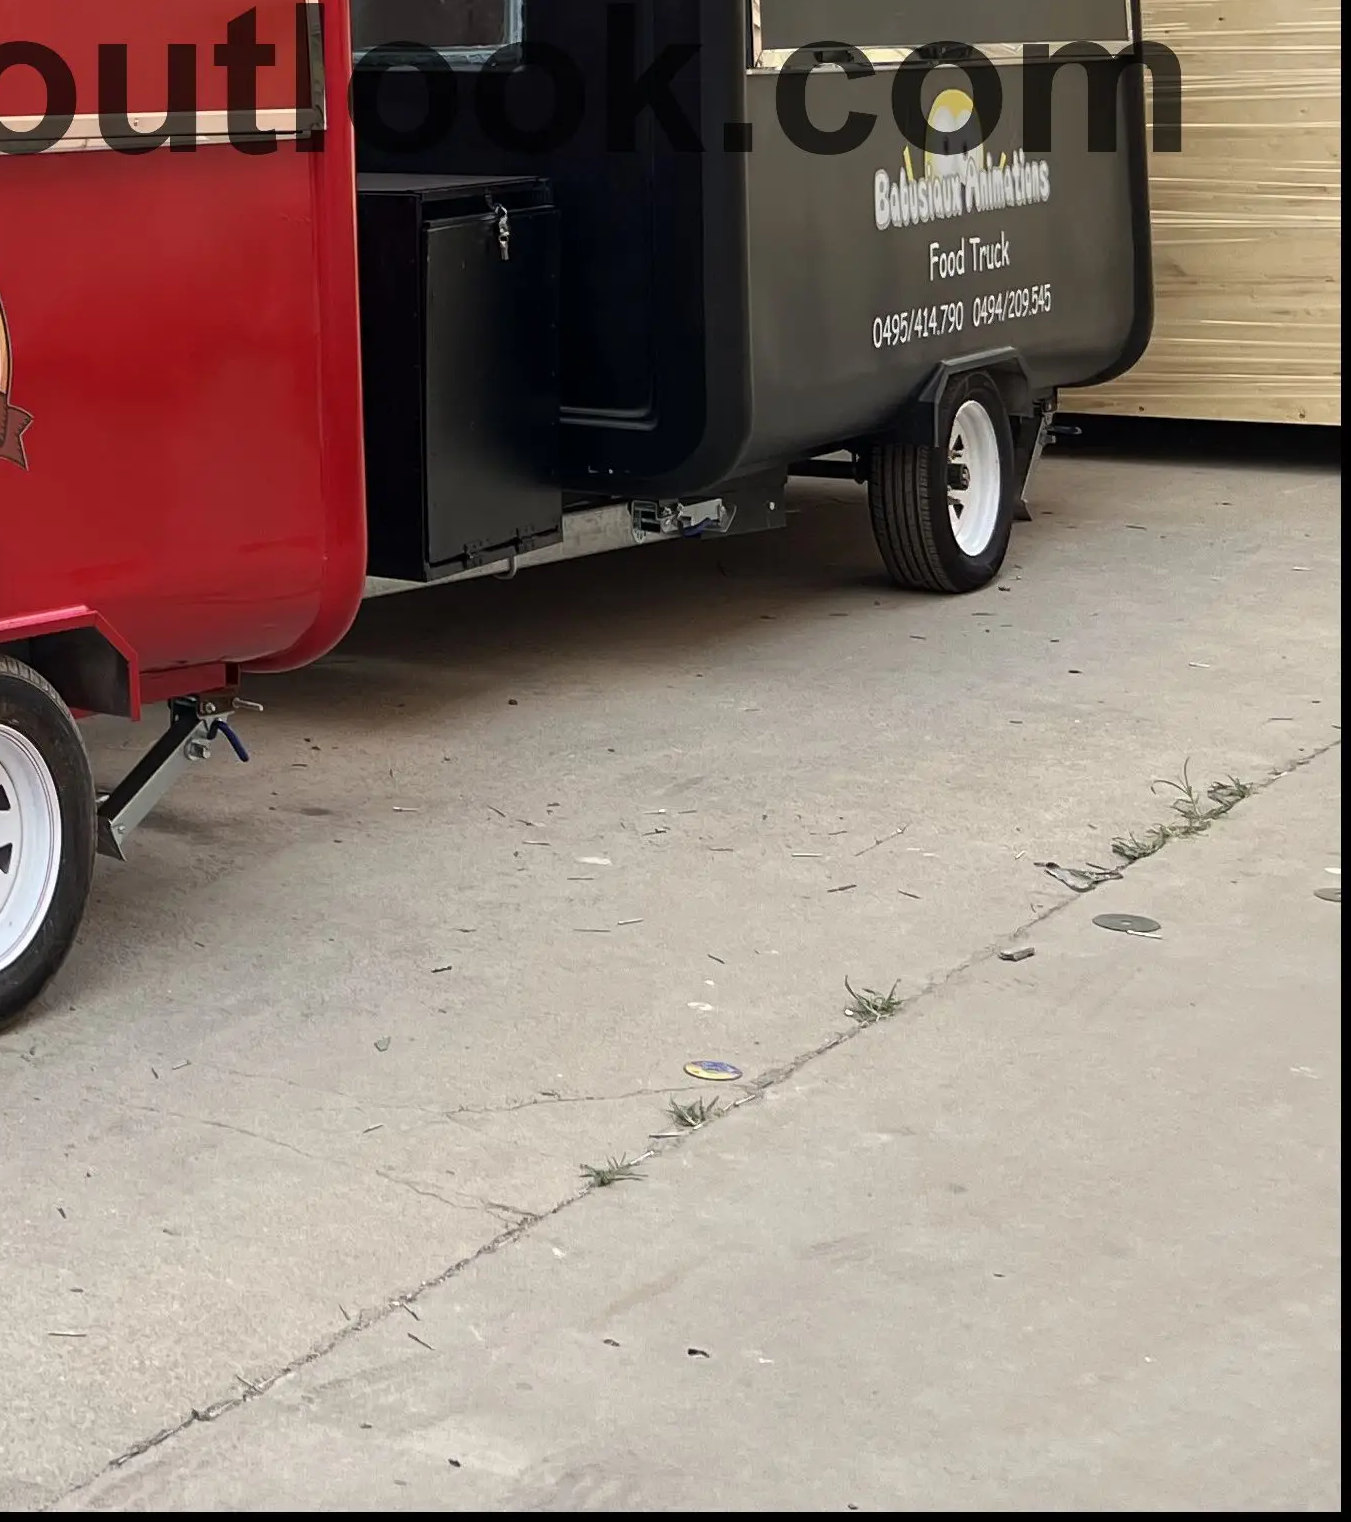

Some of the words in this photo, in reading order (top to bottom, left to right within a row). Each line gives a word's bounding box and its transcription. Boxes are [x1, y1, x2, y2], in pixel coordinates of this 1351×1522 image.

[964, 148, 1049, 214] Animations
[929, 237, 965, 281] Food
[969, 231, 1010, 274] Truck
[873, 300, 964, 348] 0495/414.790
[972, 283, 1051, 327] 0494/209.545
